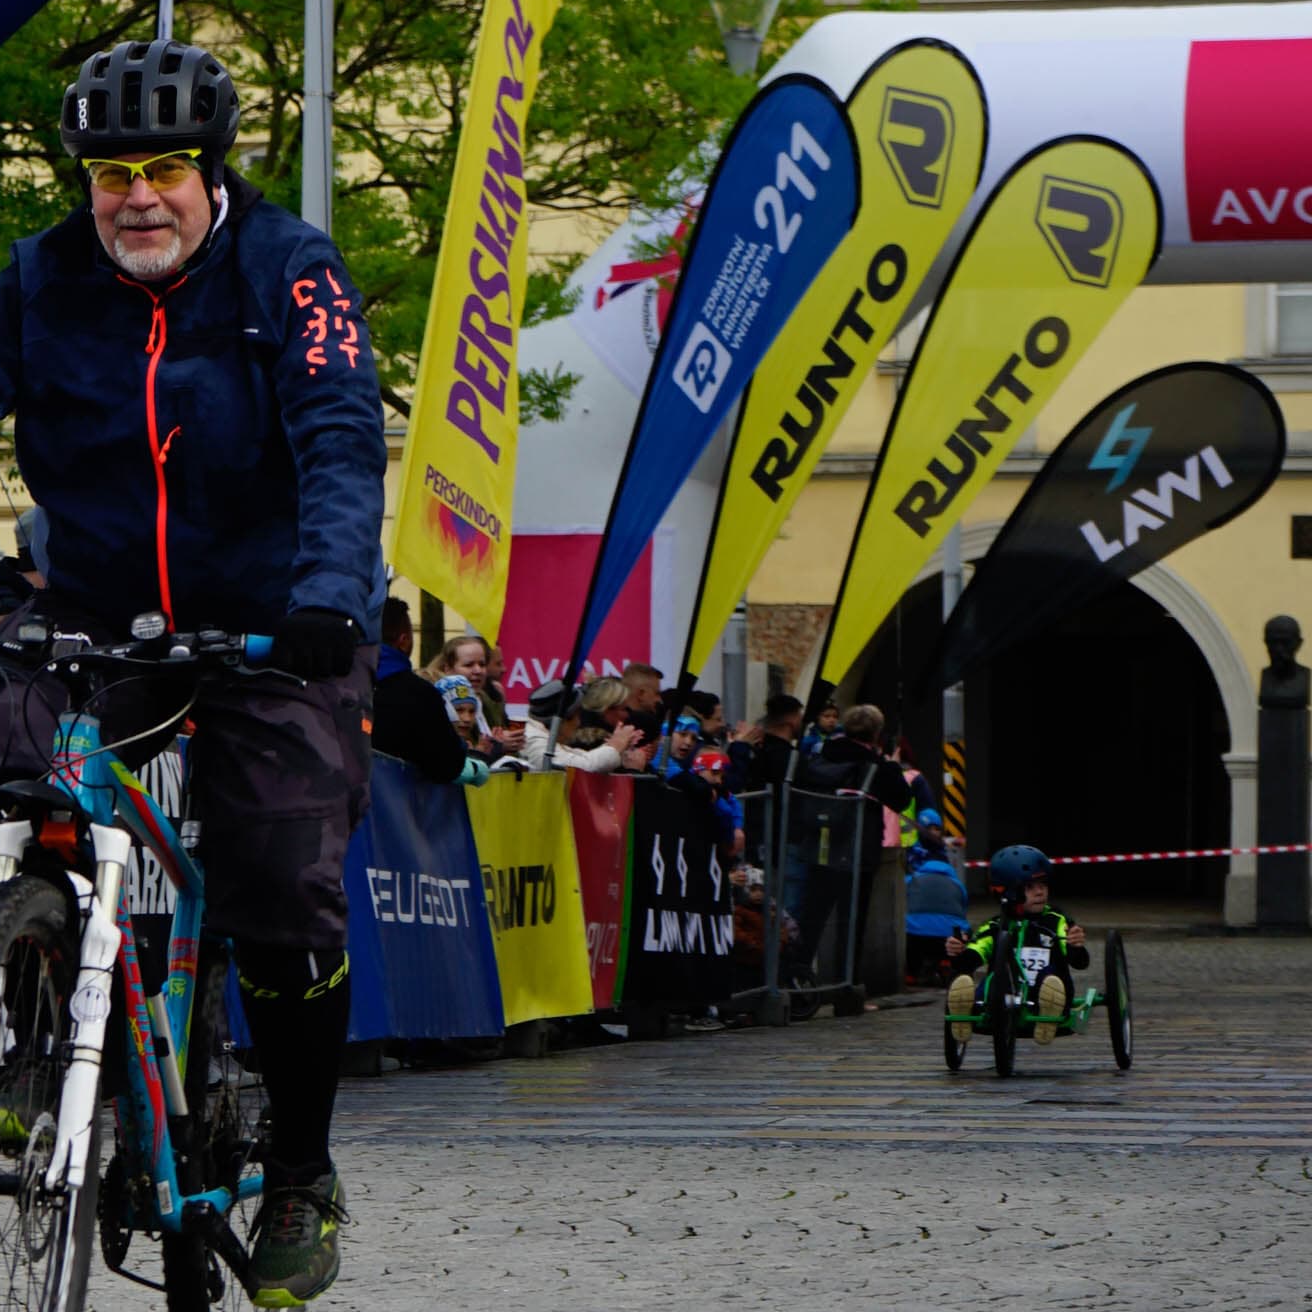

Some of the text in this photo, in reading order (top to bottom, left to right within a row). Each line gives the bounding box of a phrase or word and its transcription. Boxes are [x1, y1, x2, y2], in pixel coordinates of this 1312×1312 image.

[754, 121, 831, 254] 211
[750, 243, 907, 503] RUNTO
[893, 316, 1070, 538] RUNTO
